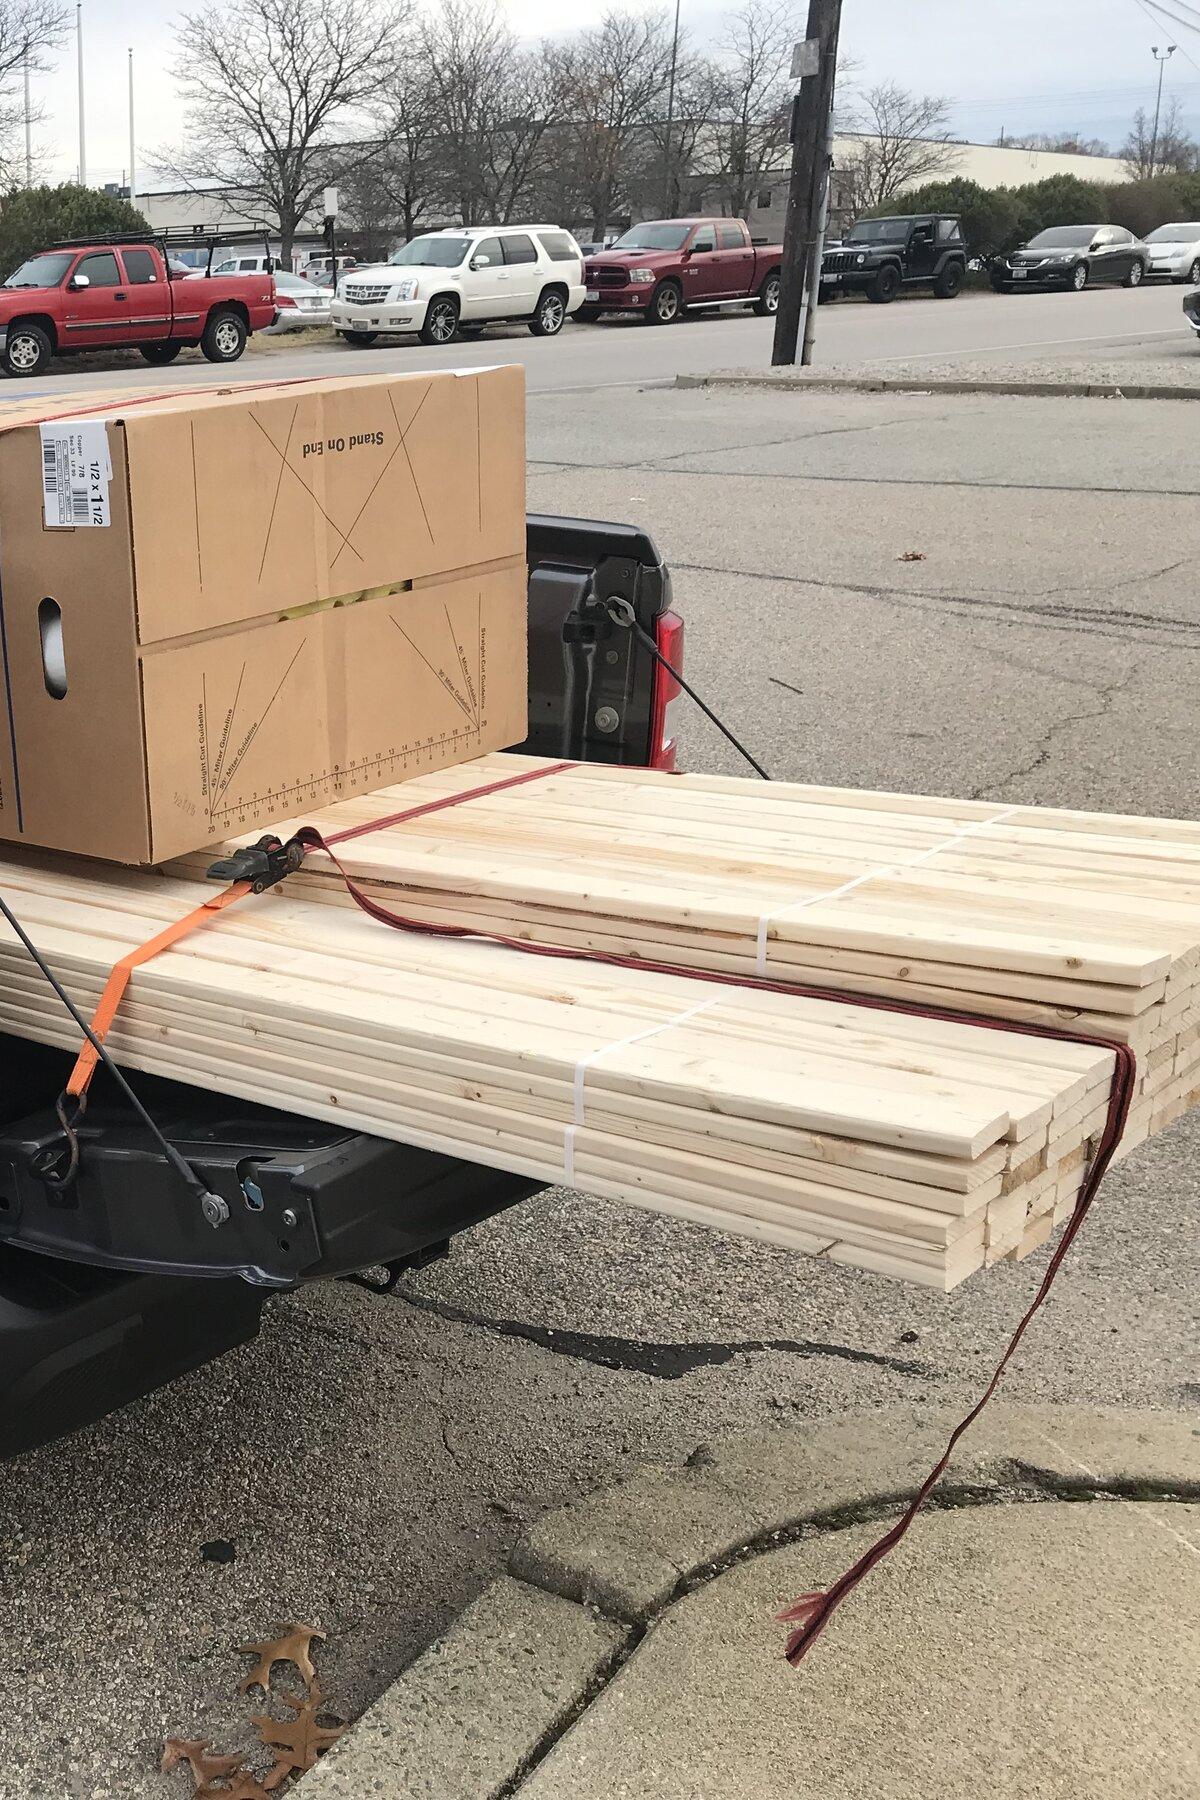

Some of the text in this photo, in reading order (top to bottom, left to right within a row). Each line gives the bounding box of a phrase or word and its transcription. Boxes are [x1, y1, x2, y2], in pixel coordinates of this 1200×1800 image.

[303, 431, 384, 458] Stand On End
[91, 461, 100, 480] 1/2
[93, 506, 102, 524] 1/2
[214, 750, 223, 772] Miter
[220, 709, 232, 748] Guideline
[226, 757, 238, 777] Miter
[237, 722, 257, 756] Guideline
